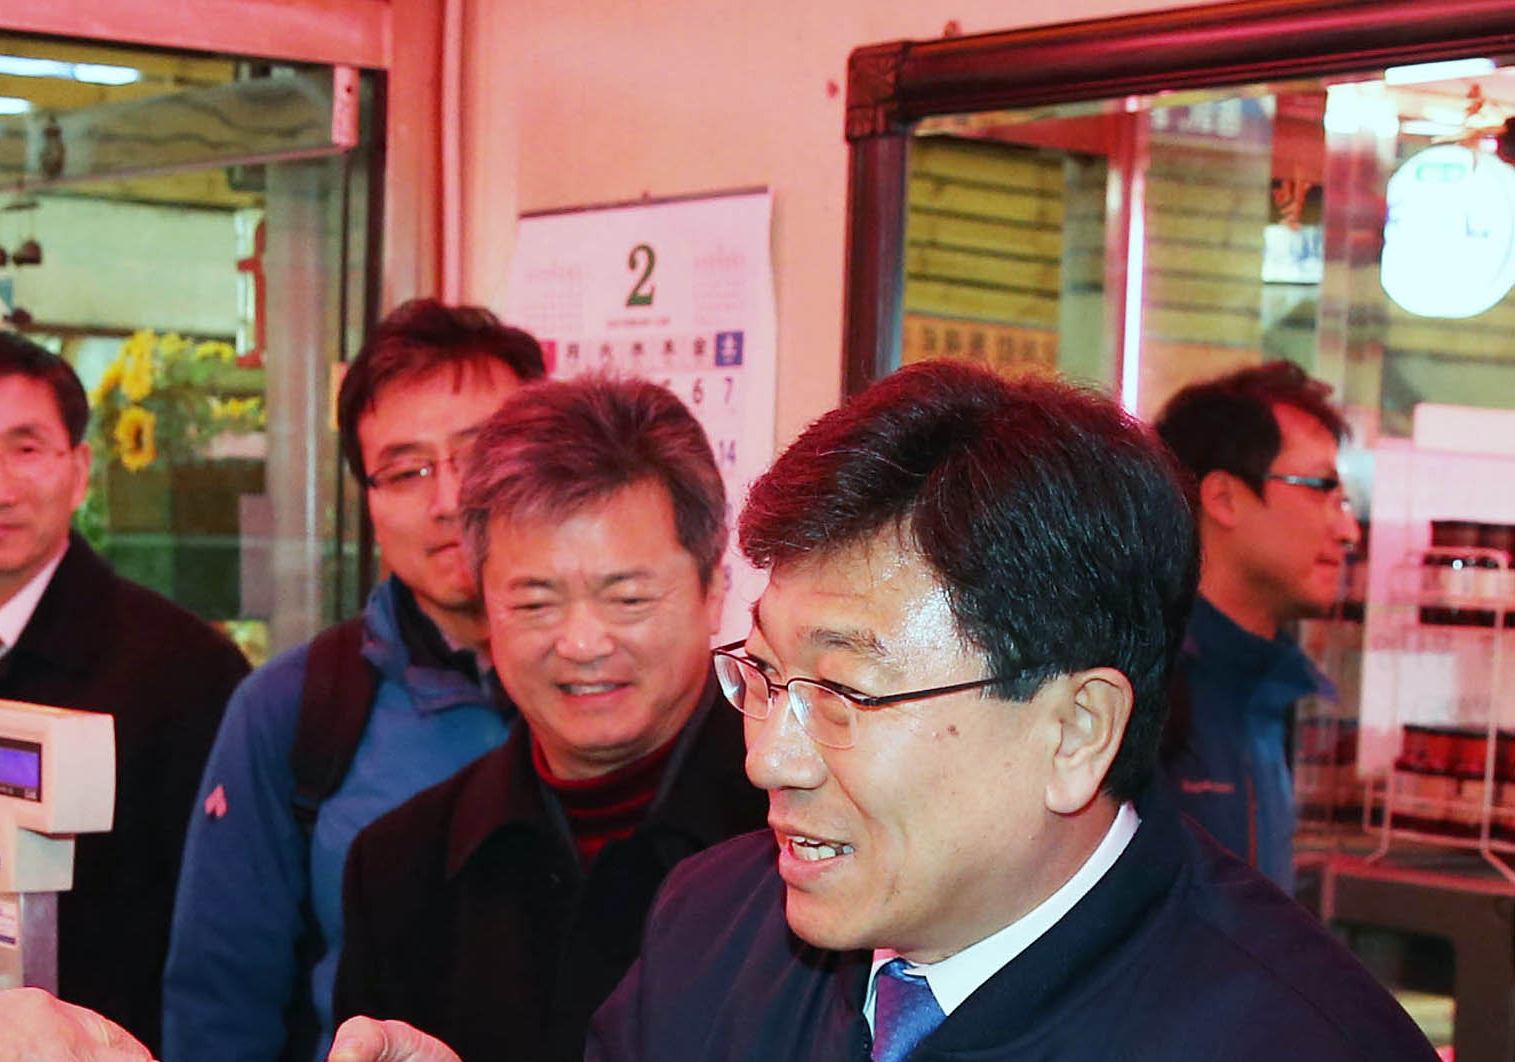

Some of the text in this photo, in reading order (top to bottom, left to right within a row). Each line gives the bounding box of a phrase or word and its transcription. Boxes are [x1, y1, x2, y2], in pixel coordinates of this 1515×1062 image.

[626, 244, 656, 307] 2
[692, 375, 734, 406] 6 7
